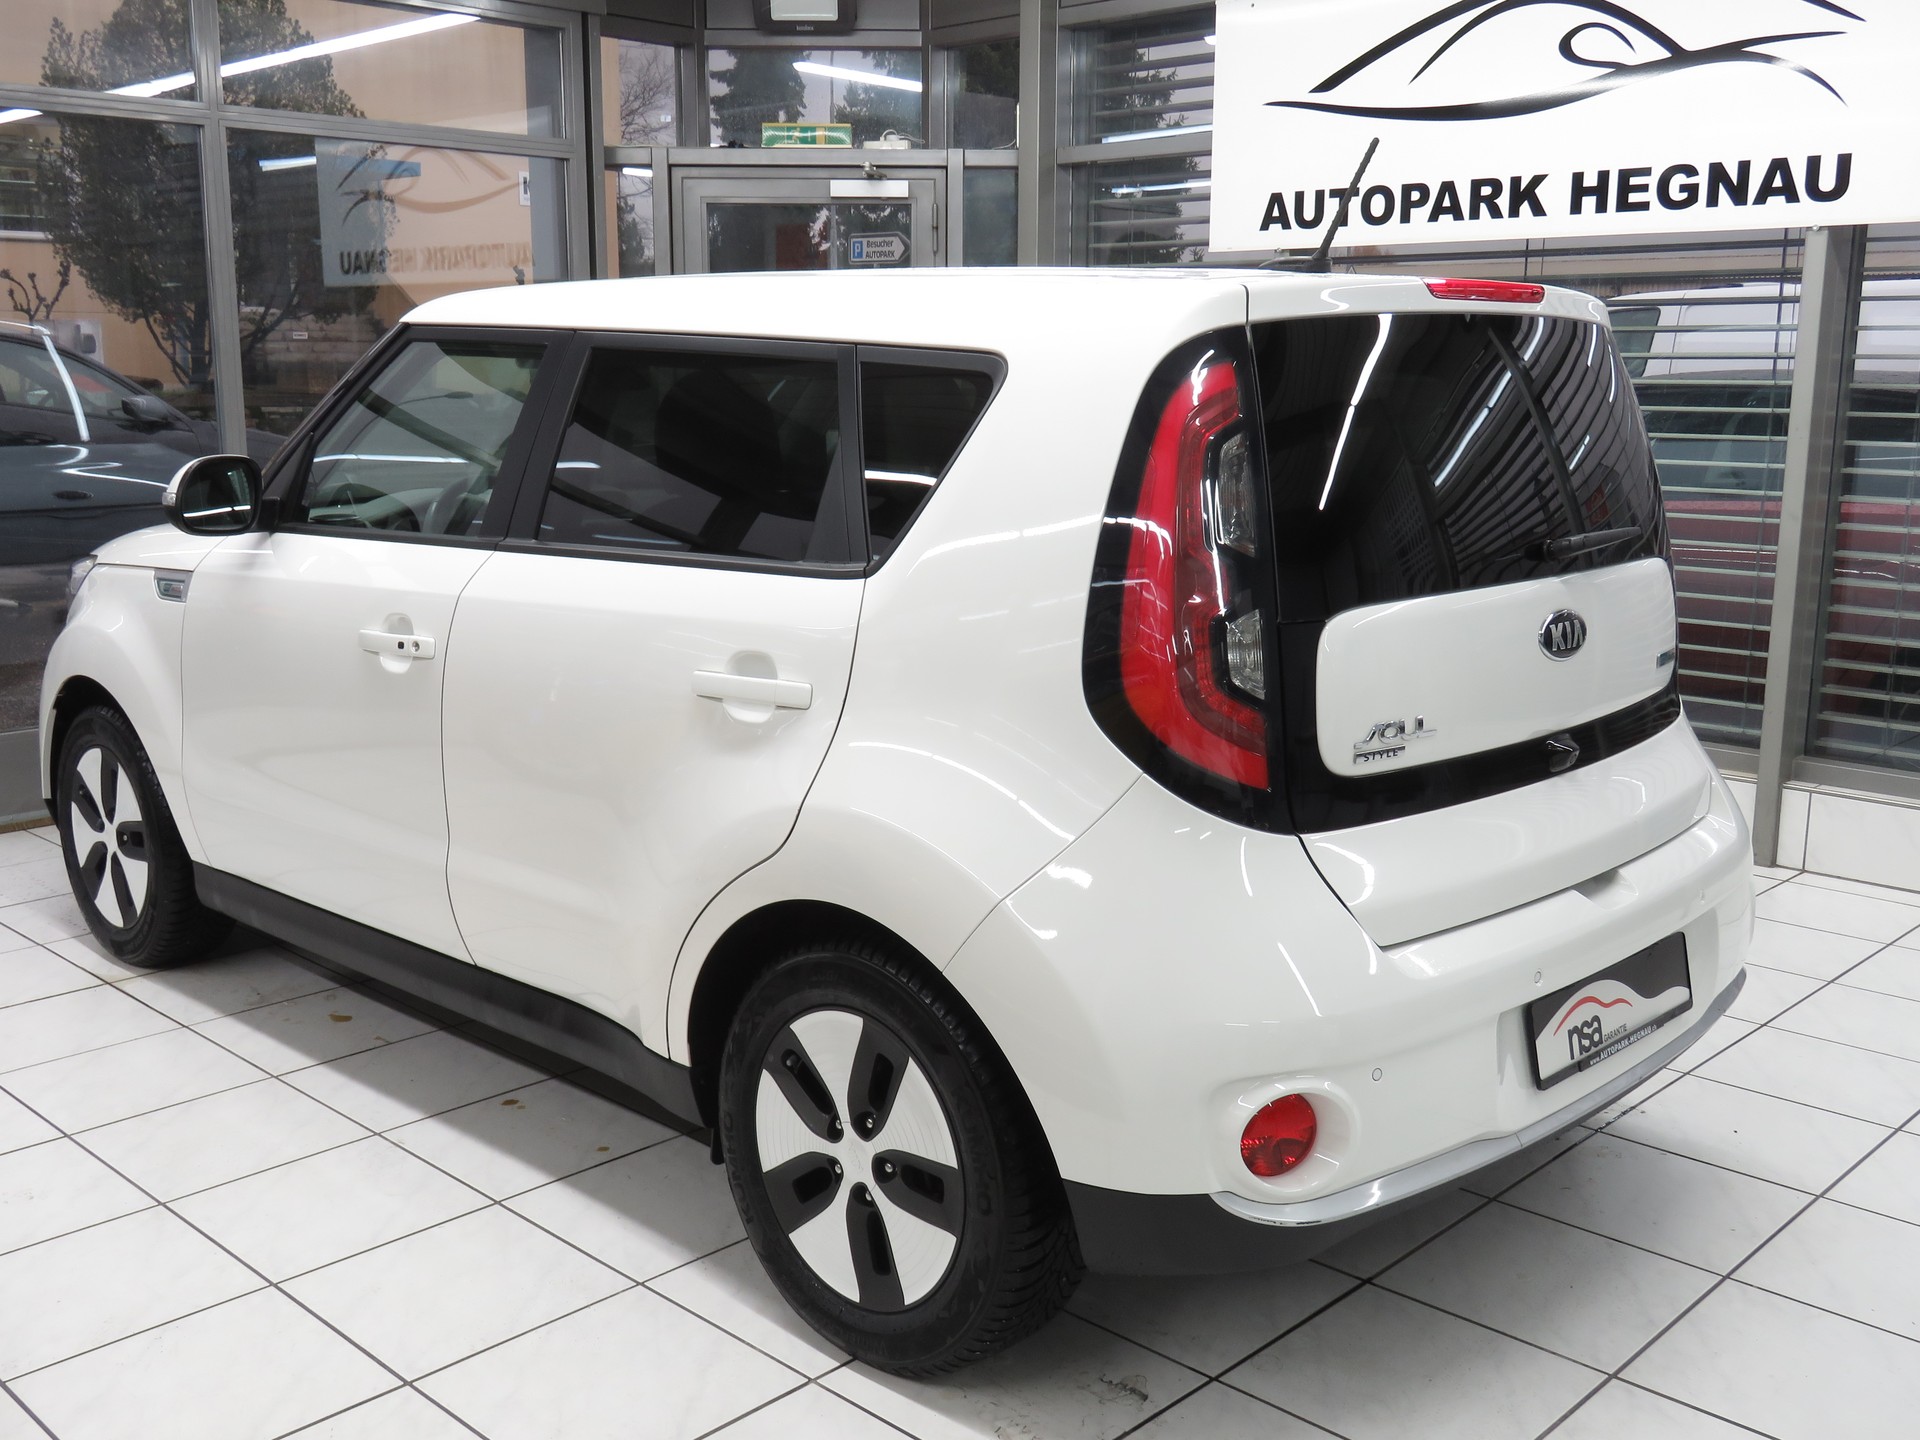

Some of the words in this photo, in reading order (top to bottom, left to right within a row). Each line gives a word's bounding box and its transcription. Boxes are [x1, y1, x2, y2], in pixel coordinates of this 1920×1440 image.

[1259, 173, 1549, 231] AUTOPARK
[1569, 152, 1853, 215] HEGNAU
[866, 240, 894, 249] Besucher
[865, 250, 896, 259] AUTOPARK
[1363, 749, 1399, 763] STYLE
[1567, 1014, 1604, 1061] nsa
[1603, 1024, 1628, 1042] GARANTIE
